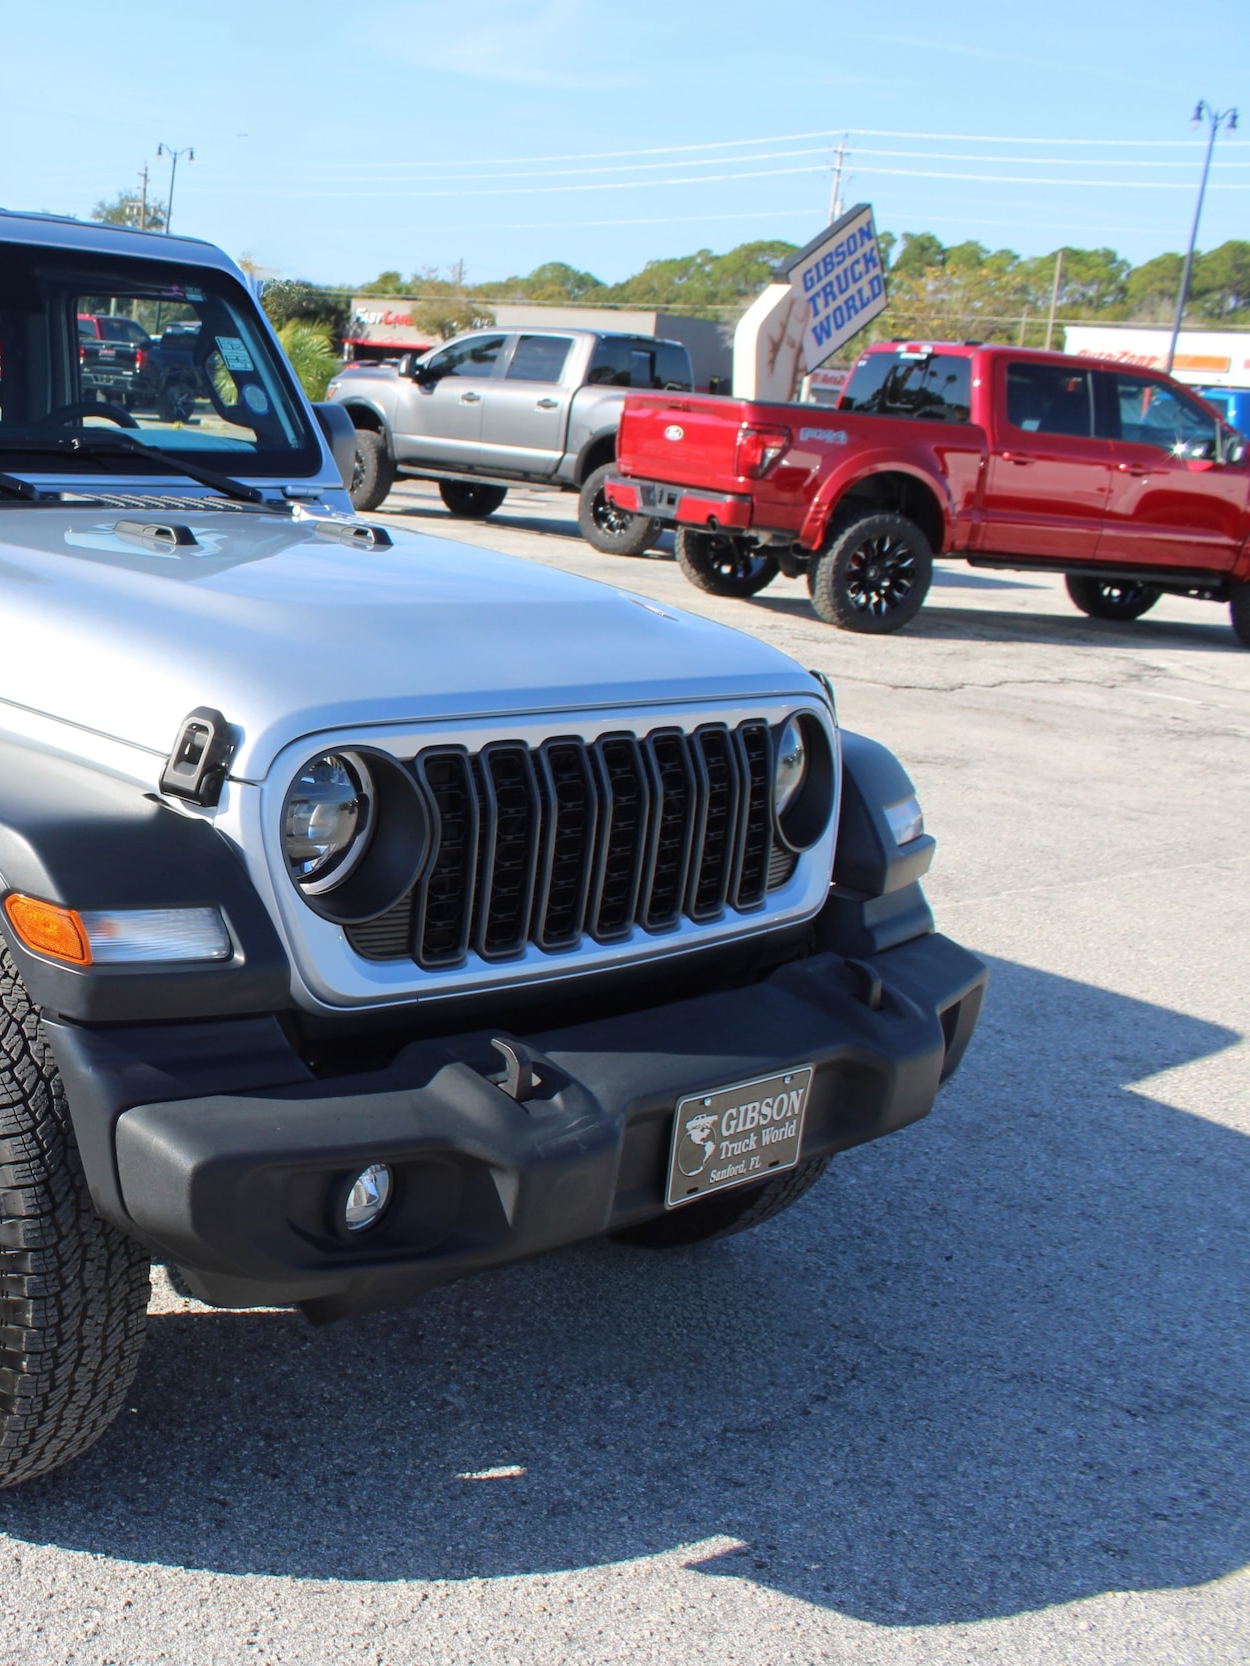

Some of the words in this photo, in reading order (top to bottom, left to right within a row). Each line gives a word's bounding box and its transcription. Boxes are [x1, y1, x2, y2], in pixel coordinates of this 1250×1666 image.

[802, 220, 874, 292] GIBSON
[807, 246, 879, 318] TRUCK
[811, 273, 883, 347] WORLD
[720, 1131, 758, 1160] Truck
[762, 1119, 797, 1146] World
[721, 1088, 804, 1137] GIBSON
[710, 1160, 747, 1183] Sanford,
[749, 1155, 762, 1171] FL
